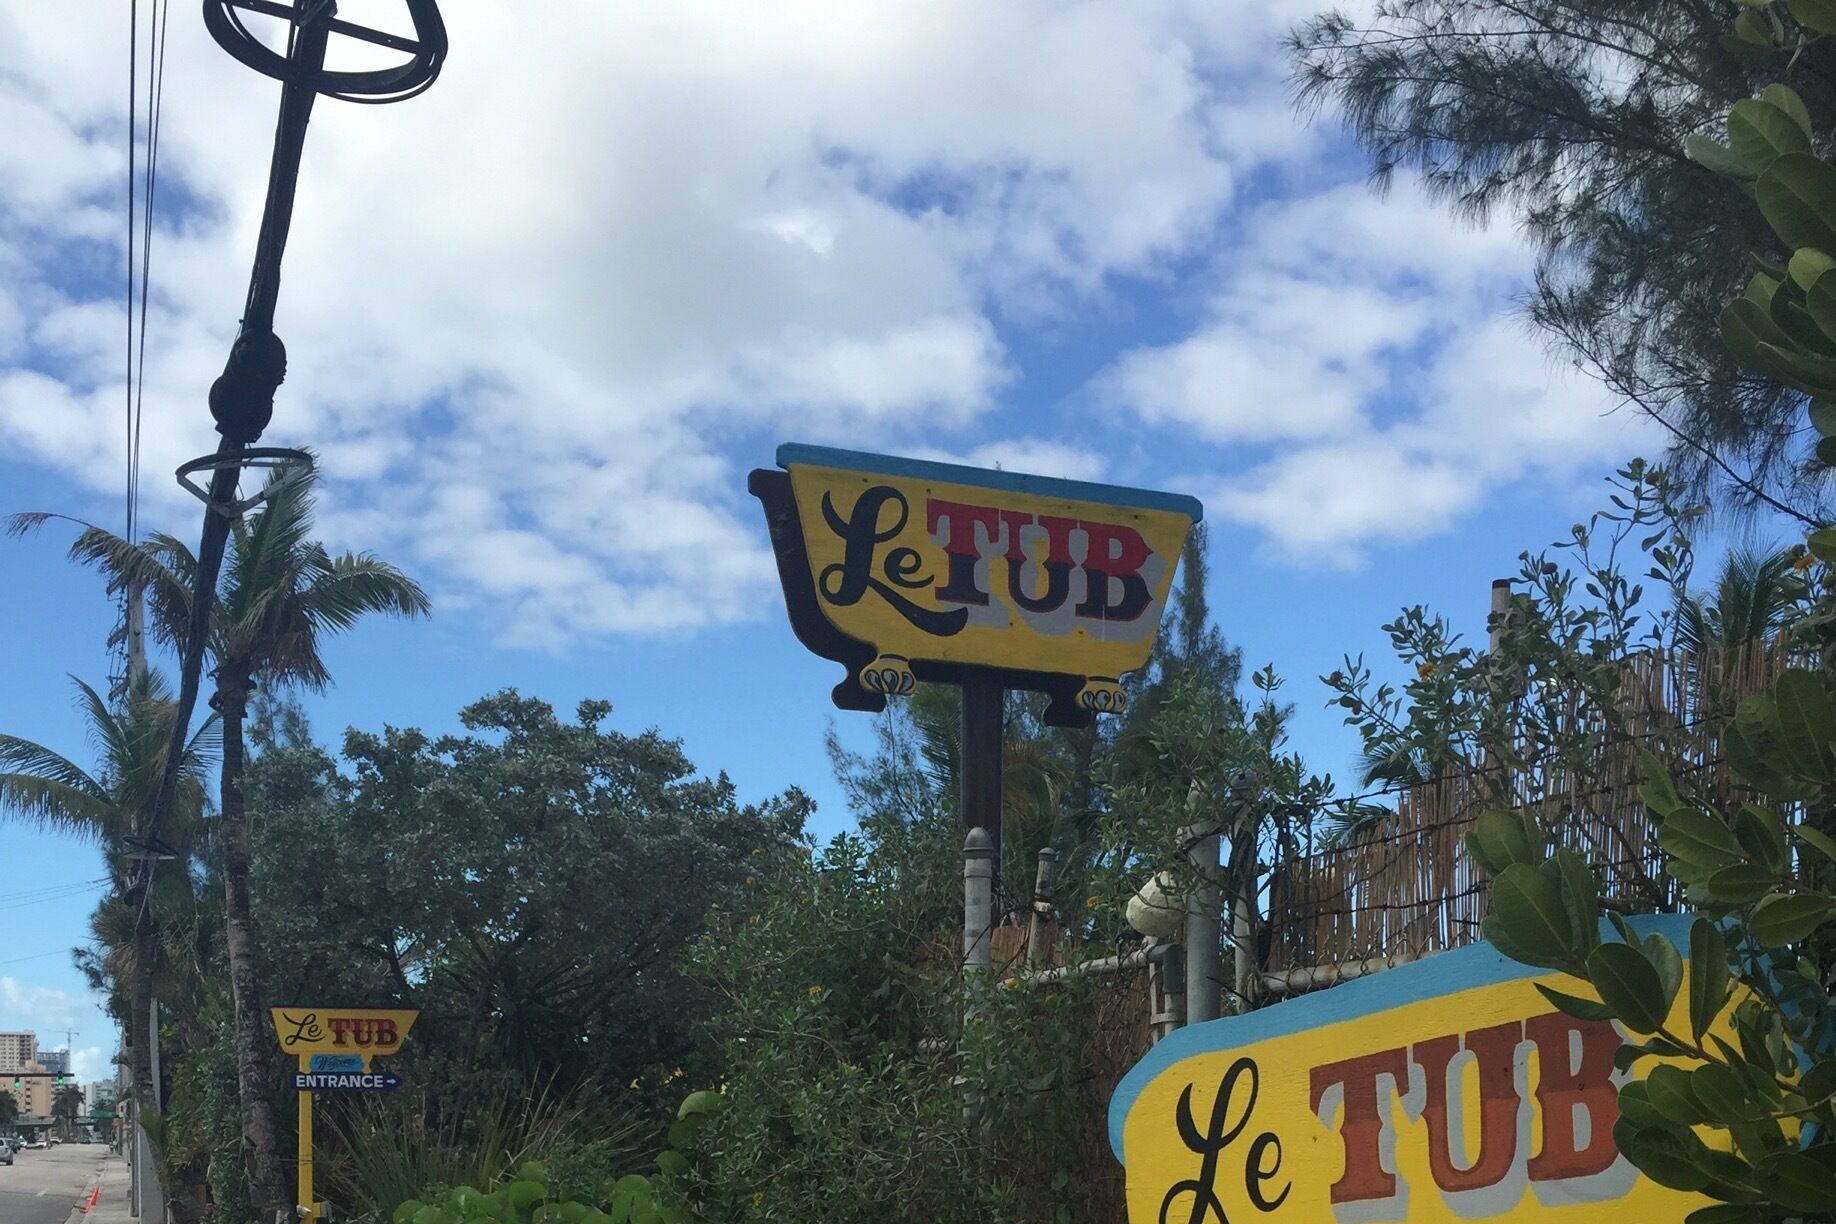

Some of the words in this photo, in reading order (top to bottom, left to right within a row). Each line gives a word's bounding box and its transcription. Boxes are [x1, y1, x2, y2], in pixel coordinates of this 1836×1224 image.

[819, 485, 968, 637] Le
[927, 498, 1155, 622] TUB
[283, 1012, 326, 1045] Le
[328, 1018, 399, 1045] TUB
[296, 1075, 383, 1088] ENTRANCE
[1310, 1010, 1624, 1205] TUB
